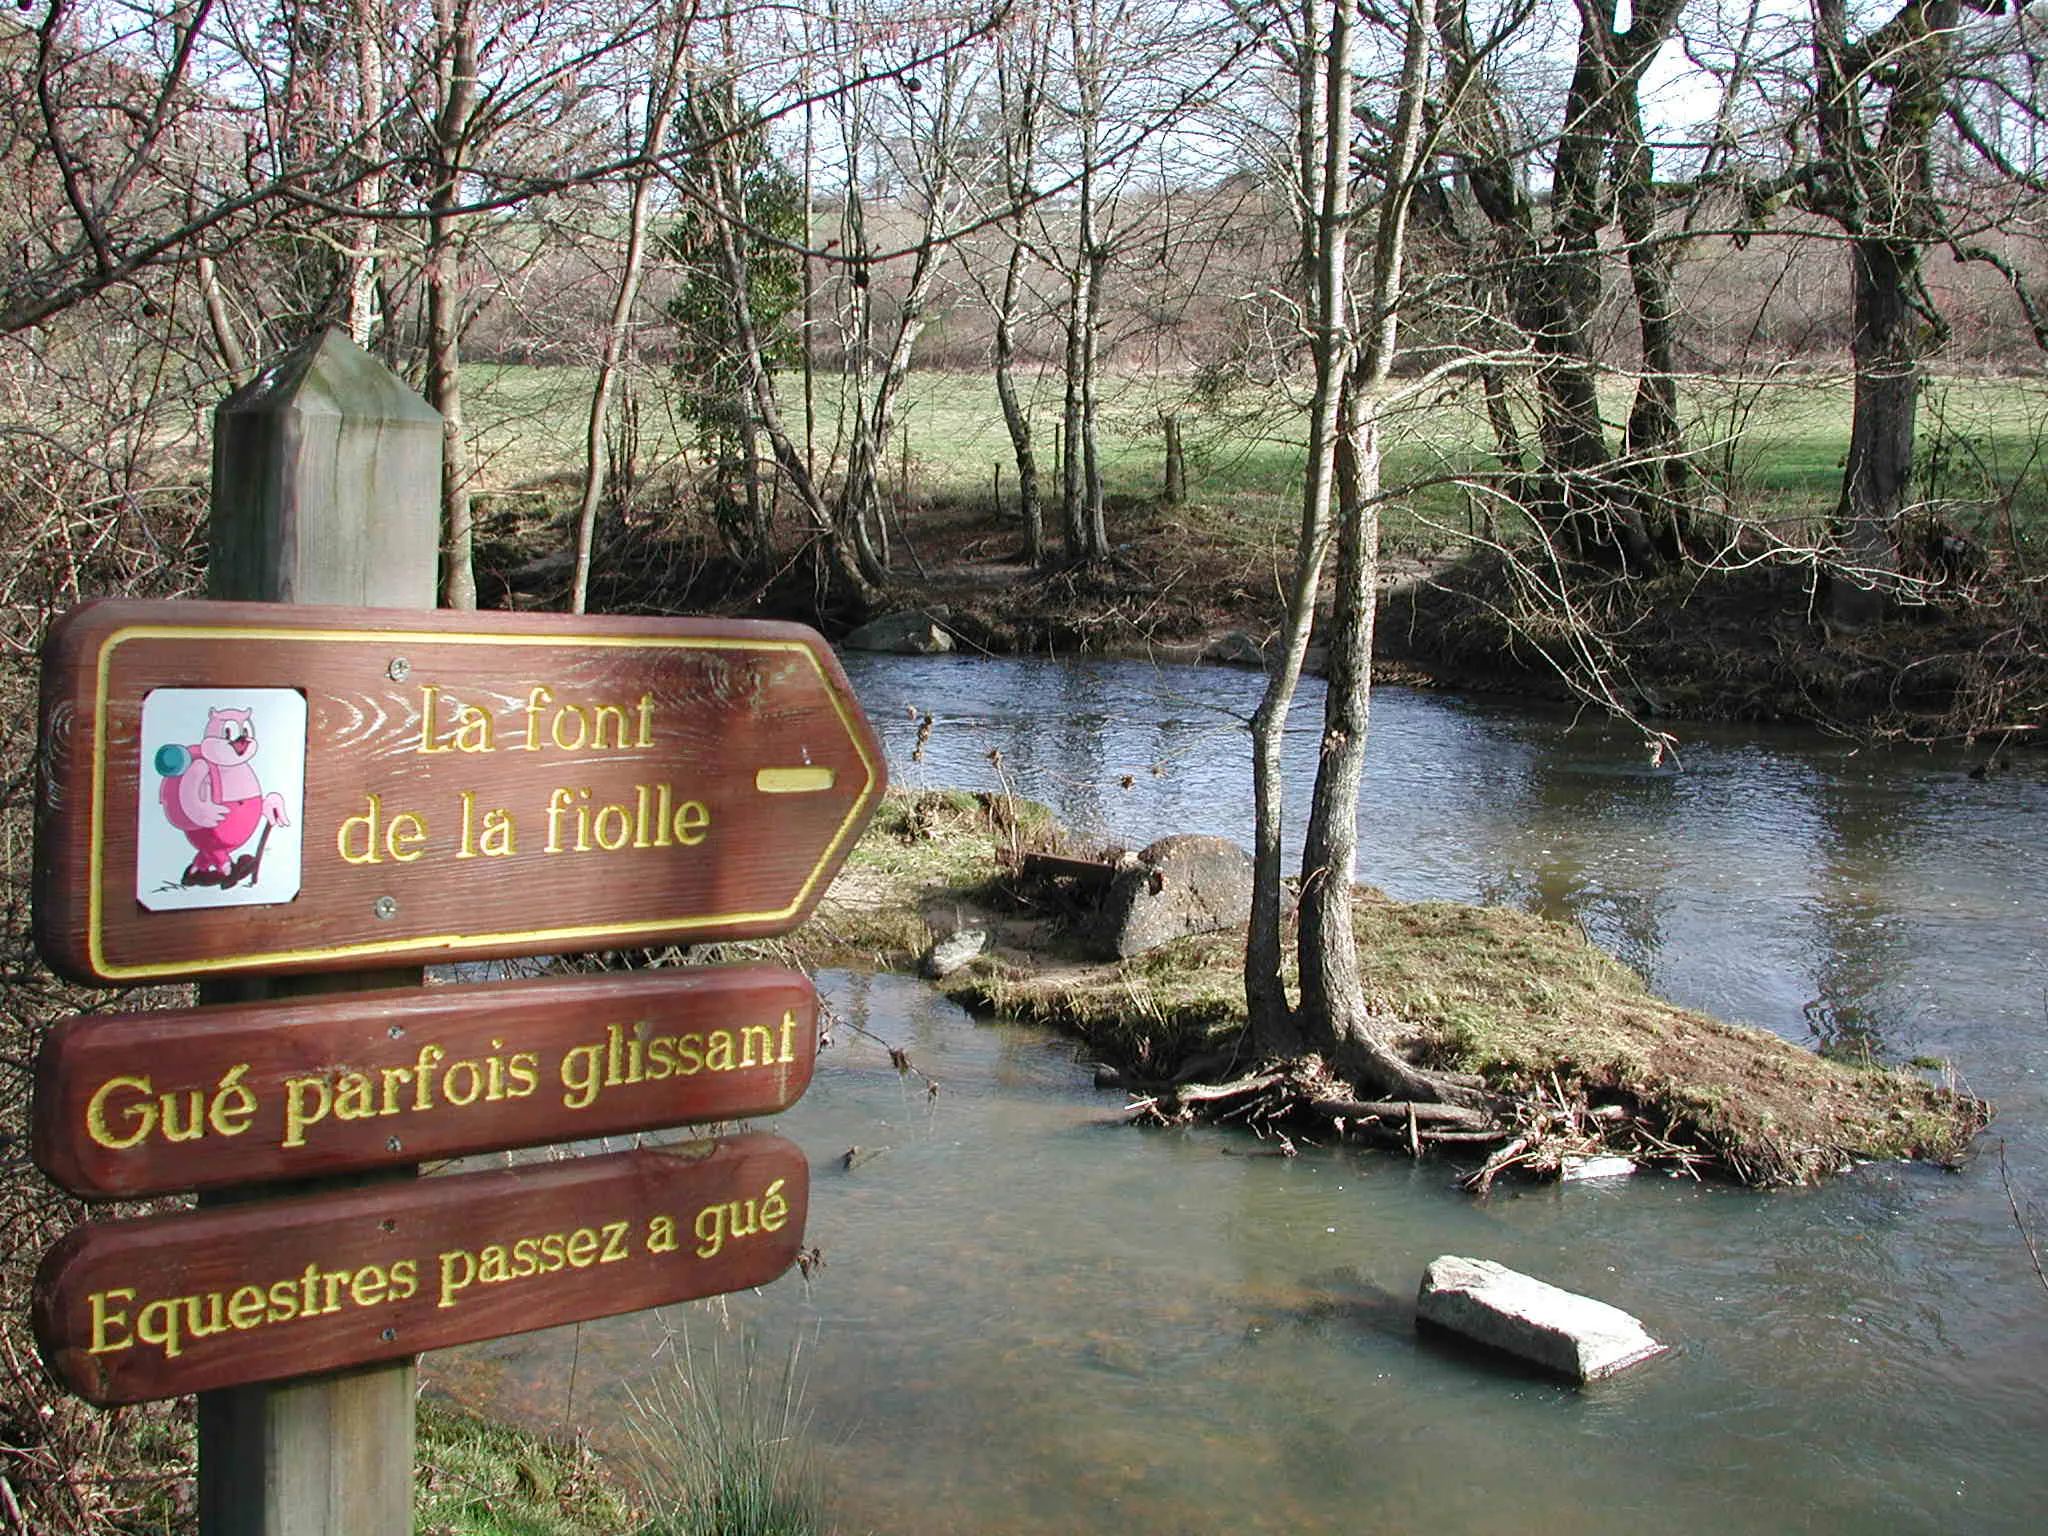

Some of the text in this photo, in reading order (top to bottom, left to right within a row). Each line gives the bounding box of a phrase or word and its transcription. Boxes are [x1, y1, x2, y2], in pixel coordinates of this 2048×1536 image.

[419, 686, 654, 753] La font
[337, 784, 710, 864] de la fiolle
[86, 1010, 797, 1150] Gué parfois glissant
[88, 1179, 788, 1358] Equestres passez a gué
